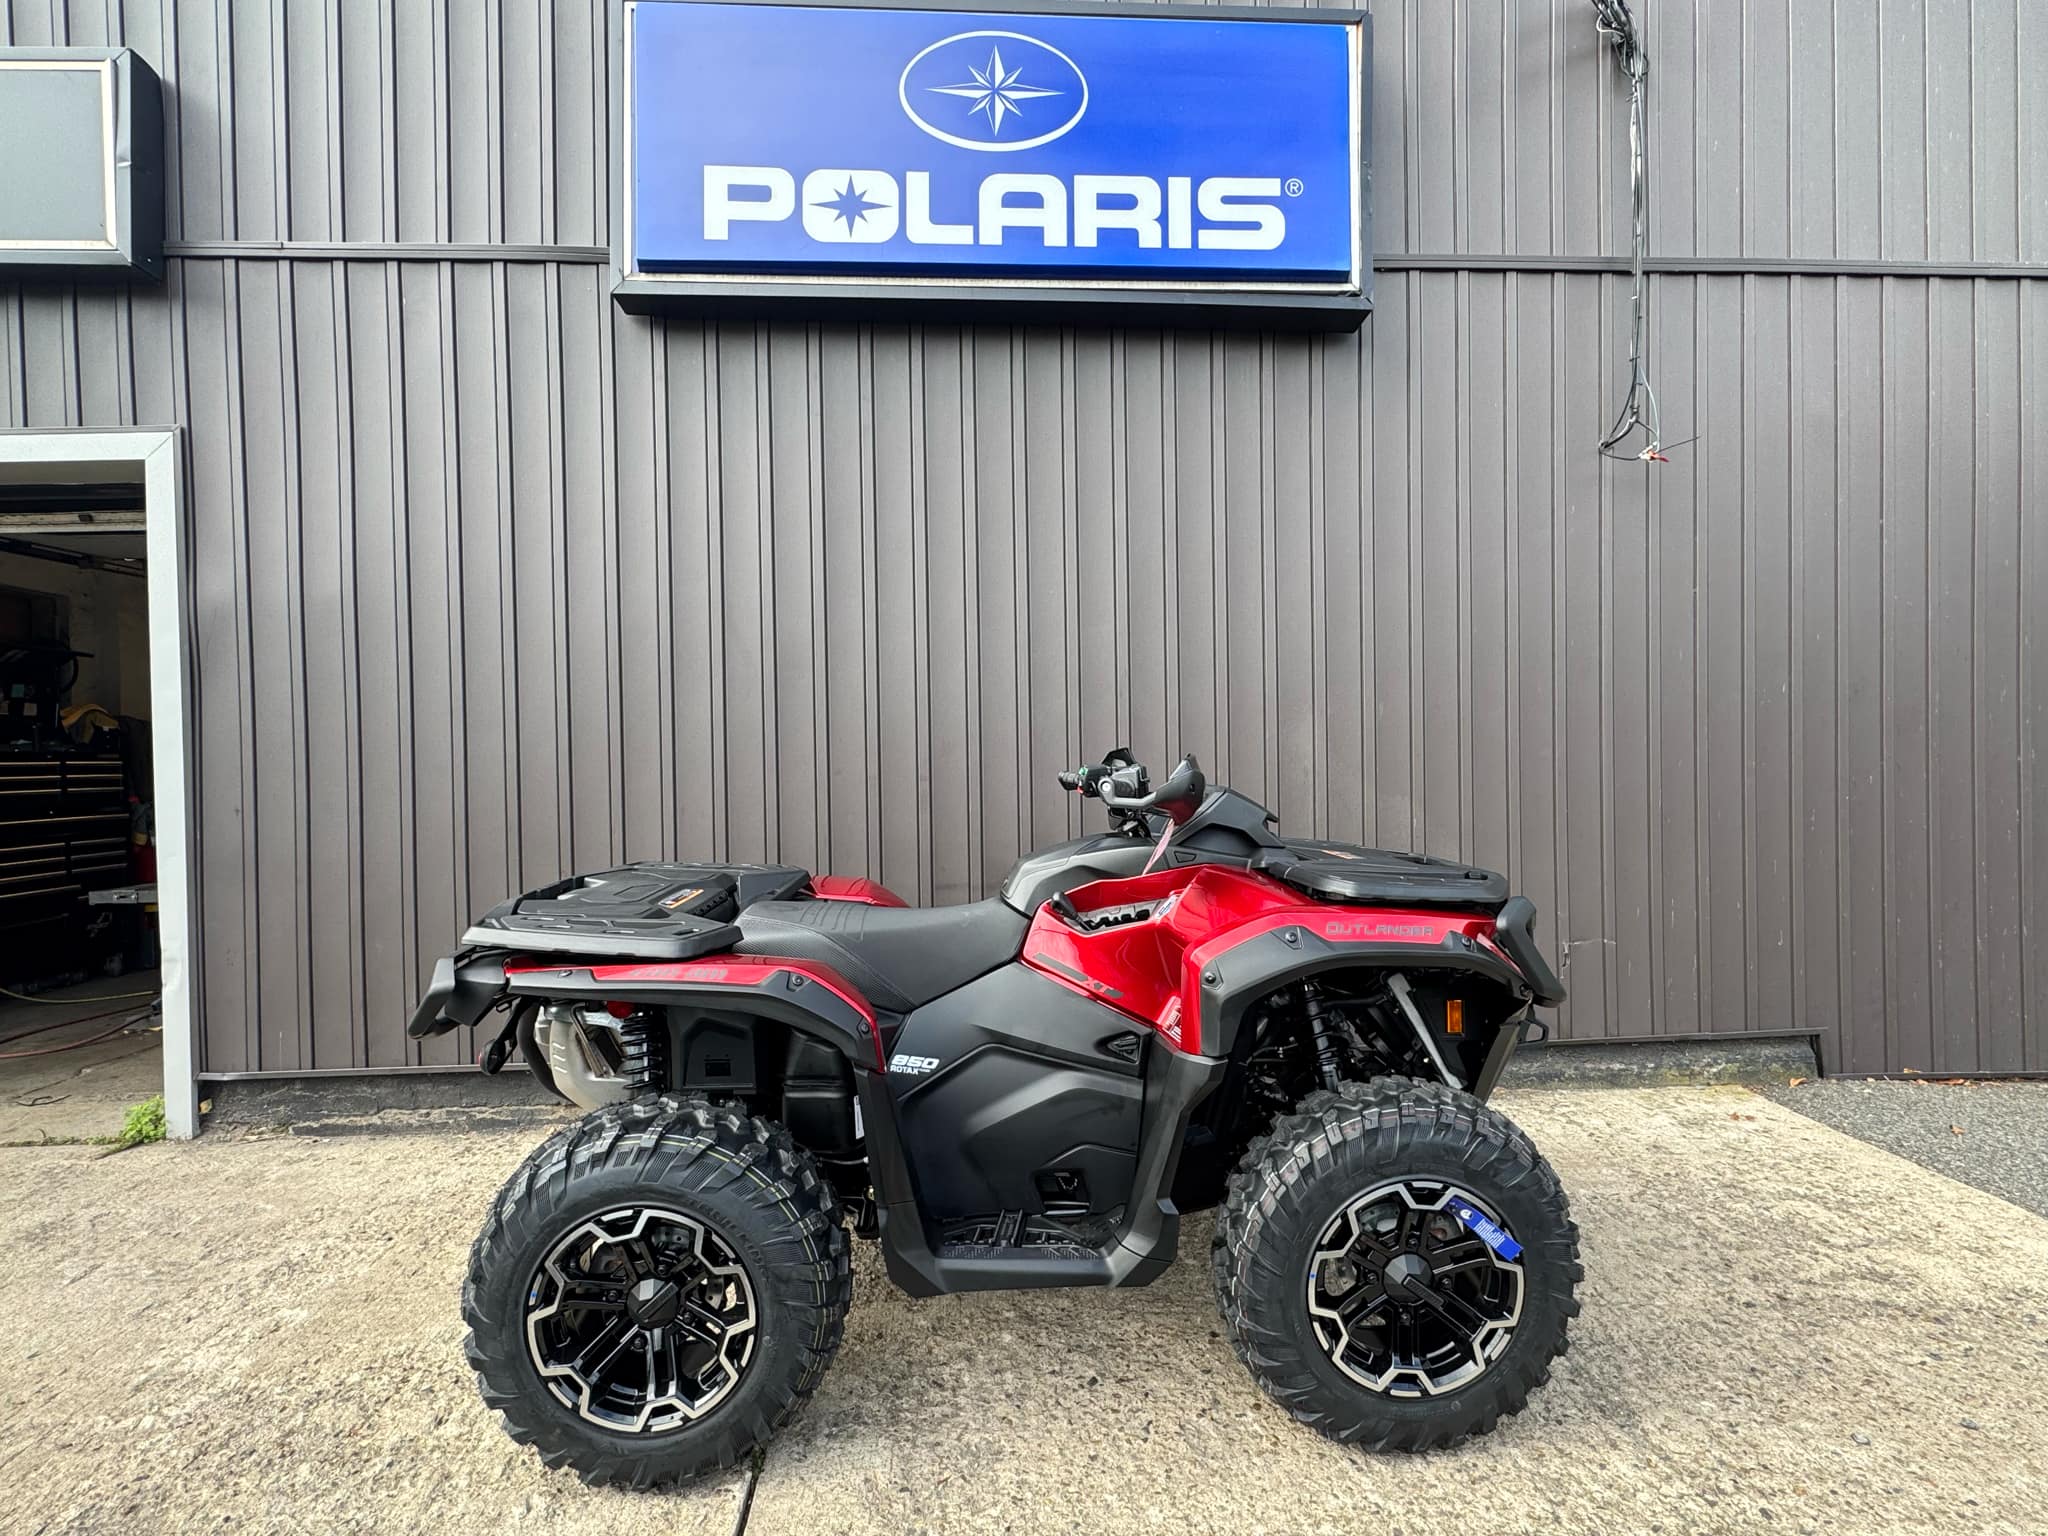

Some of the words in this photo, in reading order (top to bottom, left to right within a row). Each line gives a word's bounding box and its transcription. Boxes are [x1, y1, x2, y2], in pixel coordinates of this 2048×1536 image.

[1326, 921, 1434, 937] OUTLANDER
[890, 1064, 919, 1076] ROTAX
[891, 1054, 940, 1070] 850
